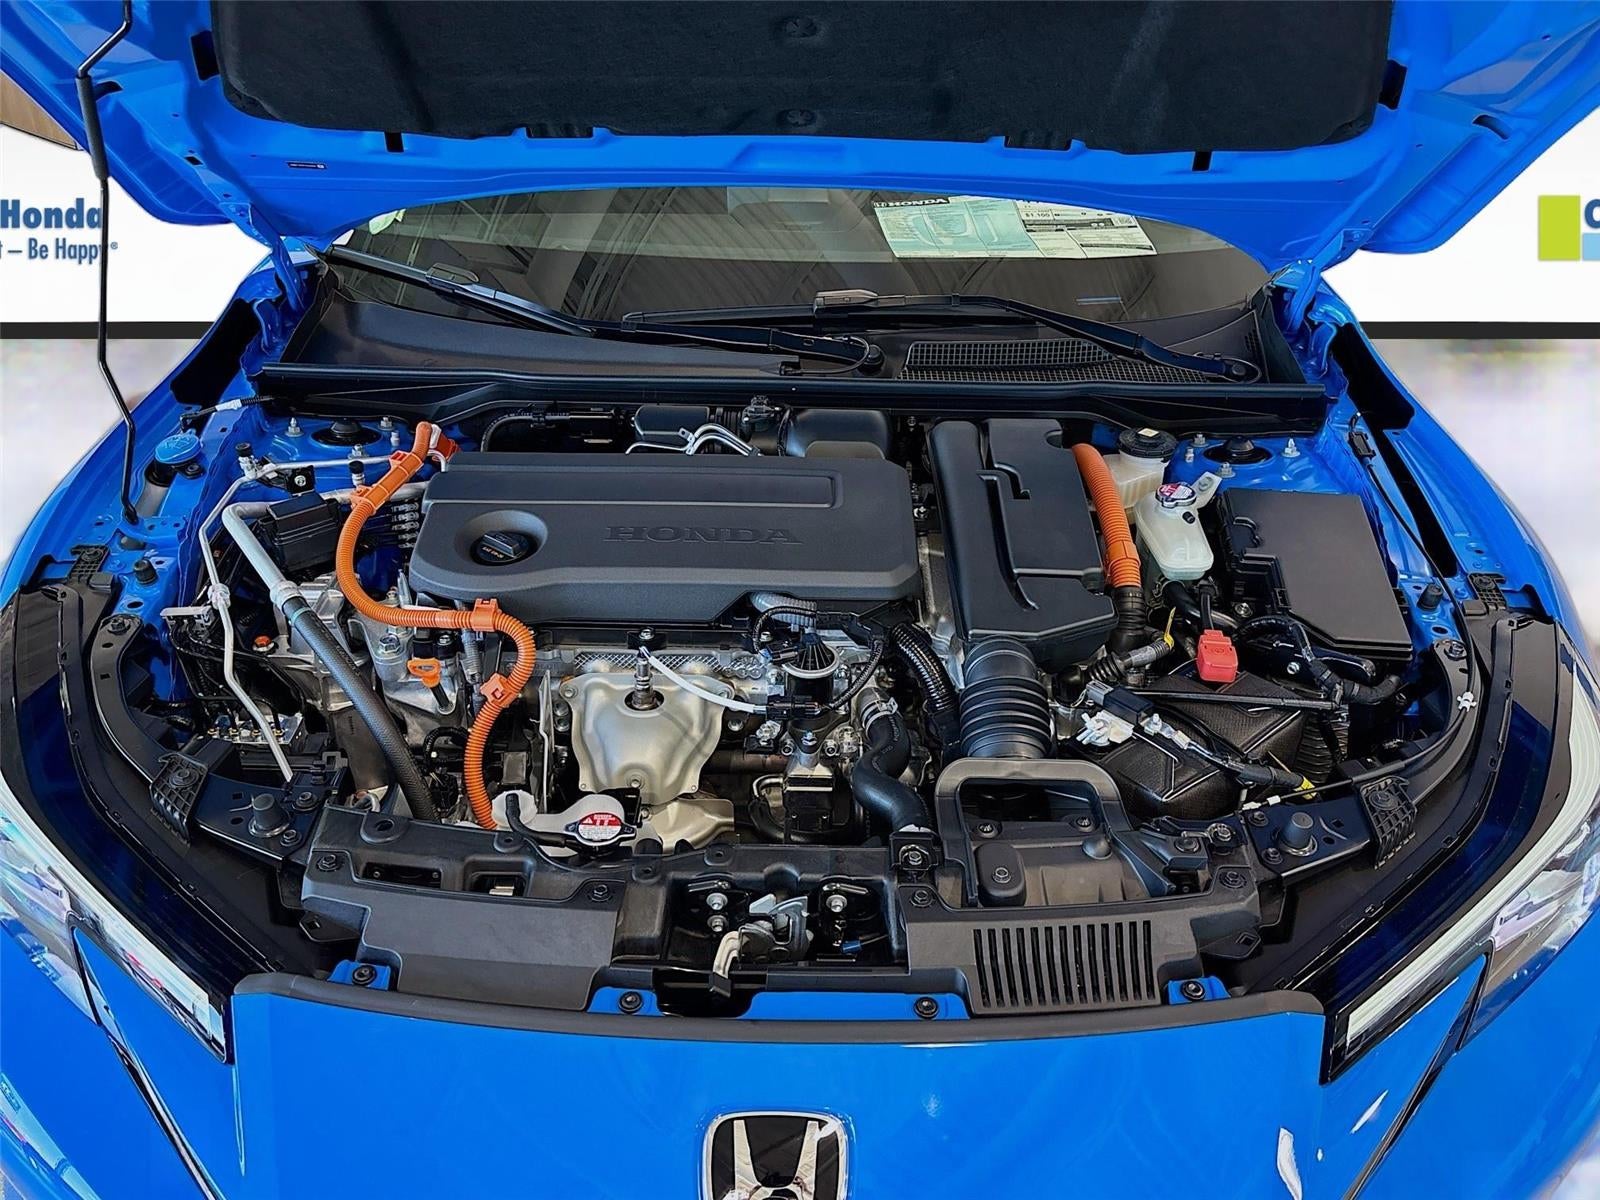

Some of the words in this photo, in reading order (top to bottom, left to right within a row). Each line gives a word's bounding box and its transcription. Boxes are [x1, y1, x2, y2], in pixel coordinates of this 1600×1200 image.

[887, 198, 948, 207] HONDA
[0, 198, 102, 229] Honda
[28, 238, 49, 259] Be
[603, 526, 802, 545] HONDA
